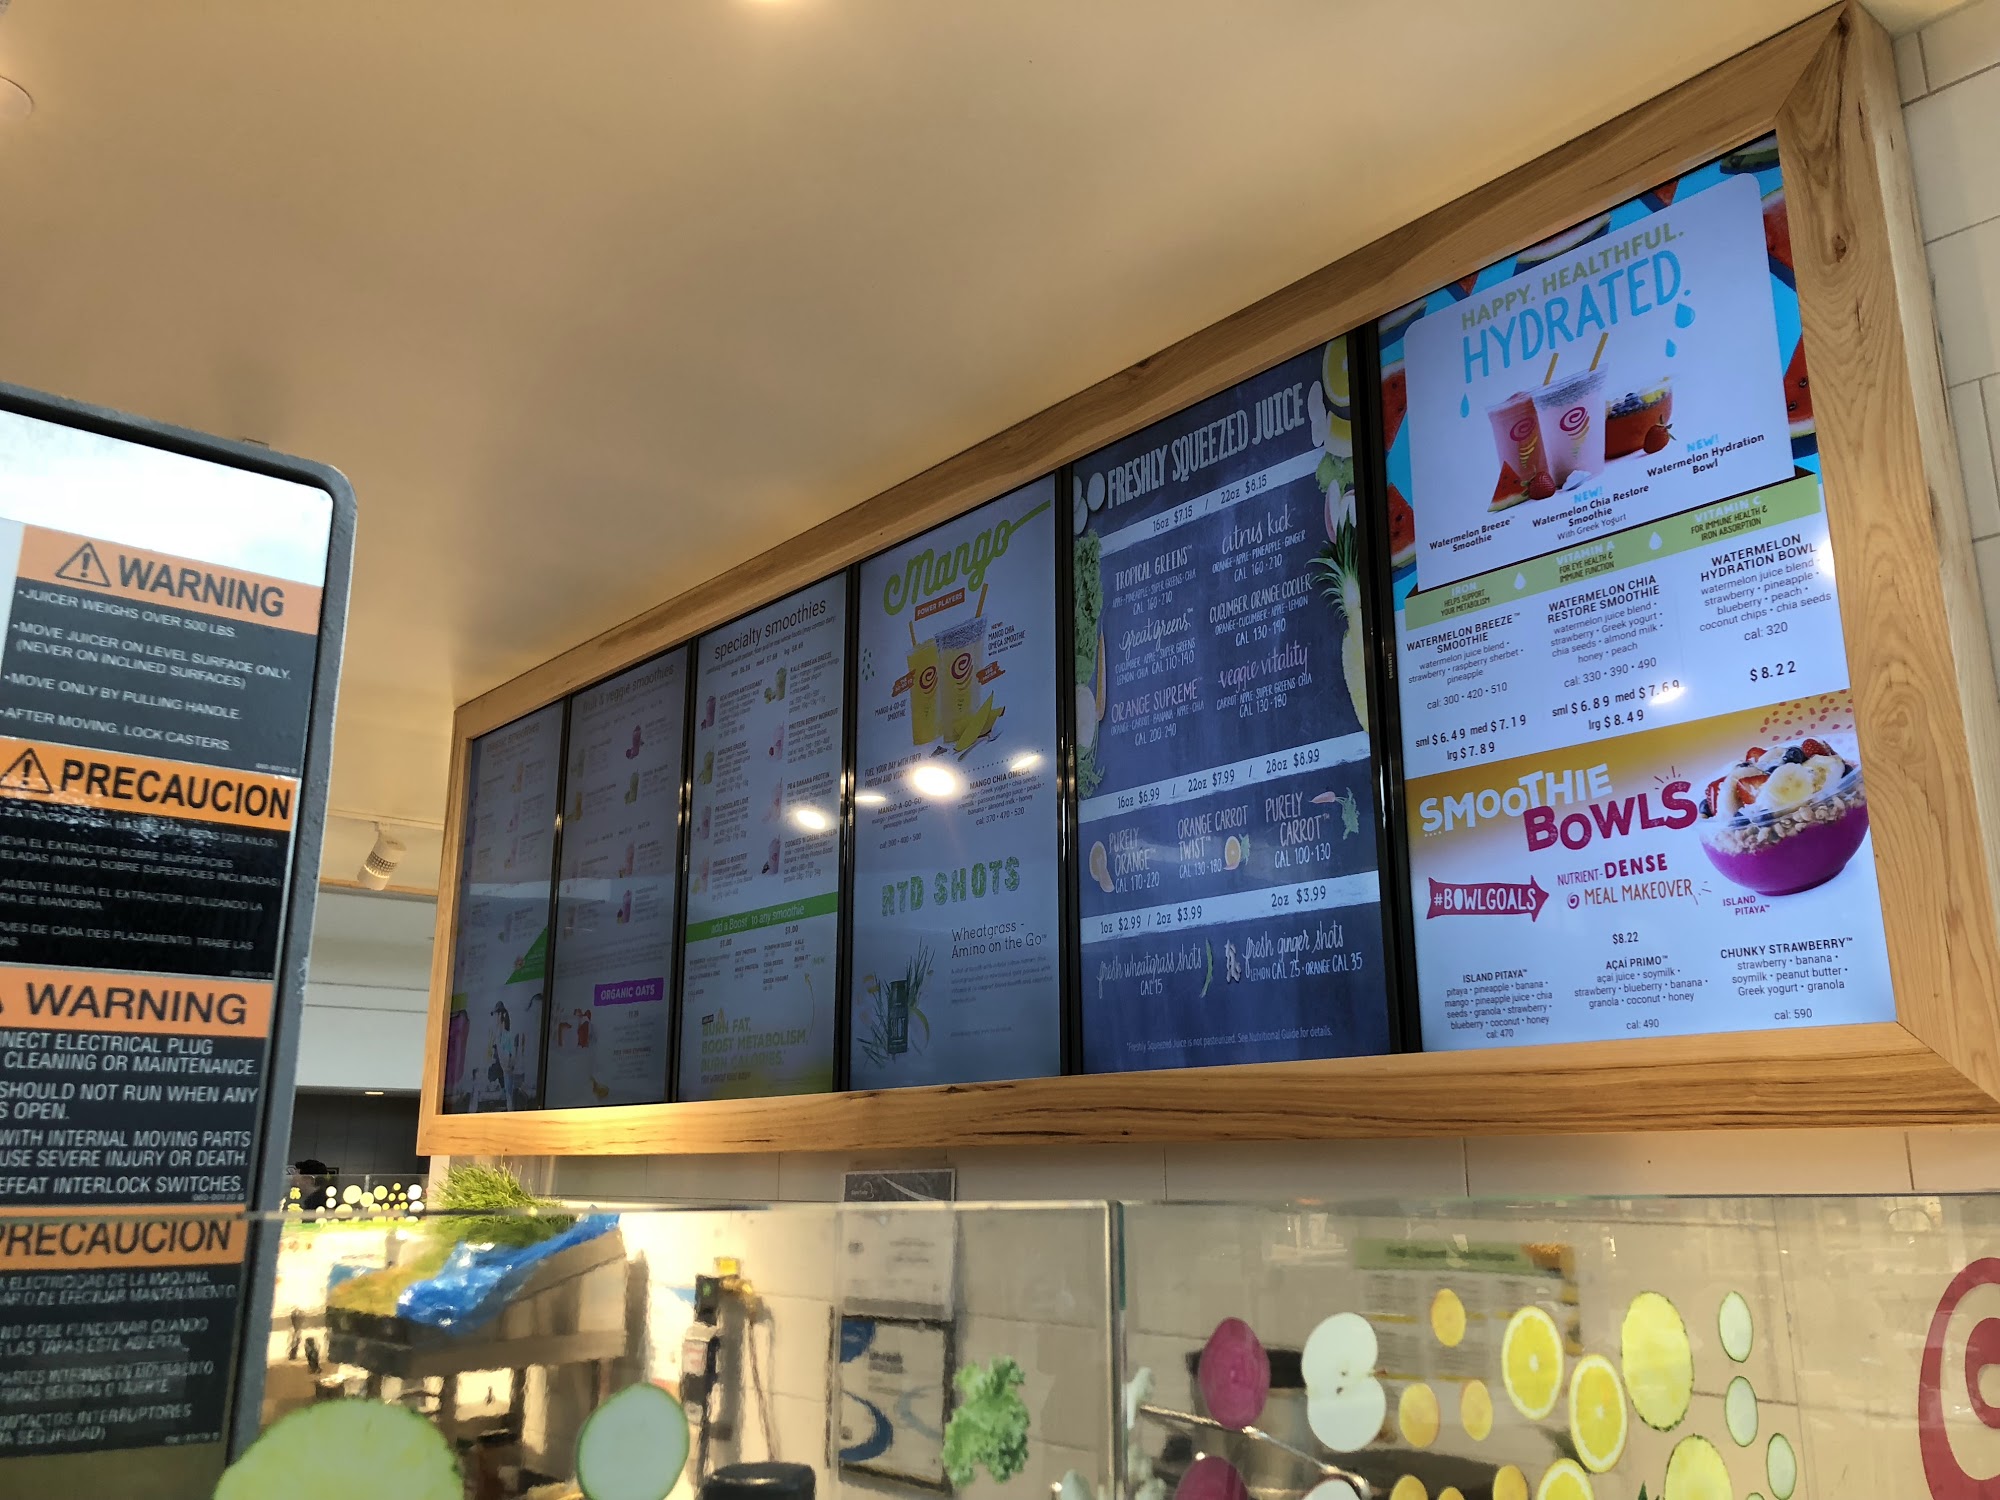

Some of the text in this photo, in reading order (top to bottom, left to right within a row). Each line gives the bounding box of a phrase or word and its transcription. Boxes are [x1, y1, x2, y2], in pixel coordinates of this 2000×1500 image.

[1461, 222, 1684, 331] HAPPY. HEALTHFUL.
[1463, 249, 1691, 384] HYDRATED.
[1107, 382, 1305, 510] FRESHLY SQUEEZED JUICE
[1647, 433, 1765, 478] Watermelon Hydration
[1692, 458, 1719, 476] Bowl
[1152, 517, 1170, 532] 16oz
[1173, 504, 1193, 525] $7.15
[1220, 488, 1240, 505] 22oz
[1532, 483, 1649, 528] Watermelon Chia Restore
[1568, 505, 1613, 528] Smoothie
[1221, 521, 1263, 555] citrus
[1429, 526, 1479, 550] Watermelon
[1452, 533, 1492, 552] Smoothie
[1711, 534, 1802, 567] WATERMELON
[883, 504, 1045, 616] Mango
[1115, 561, 1151, 592] TROPICAL
[1700, 542, 1816, 582] HYDRATION BOWL
[1700, 558, 1815, 595] watermelon juice blend
[118, 554, 285, 618] WARNING
[1209, 573, 1312, 624] CUCUMBER ORANGE COOLER
[1549, 575, 1656, 612] WATERMELON CHIA
[25, 589, 78, 608] JUICER
[82, 598, 139, 620] WEIGHS
[142, 610, 181, 628] OVER
[209, 623, 238, 638] LBS.
[916, 591, 963, 617] POWER PLAYERS
[1548, 585, 1660, 624] RESTORE SMOOTHIE
[714, 627, 762, 662] specialty
[765, 599, 826, 640] smoothies
[1406, 625, 1473, 651] WATERMELON
[1437, 631, 1489, 654] SMOOTHIE
[19, 622, 62, 640] MOVE
[67, 631, 118, 650] JUICER
[122, 639, 143, 654] ON
[146, 643, 189, 662] LEVEL
[191, 652, 253, 674] SURFACE
[16, 639, 246, 691] (NEVER ON INCLINED SURFACES)
[1218, 639, 1309, 694] veggie vitality
[10, 672, 55, 691] MOVE
[58, 679, 98, 697] ONLY
[101, 686, 120, 700] BY
[123, 691, 183, 711] PULLING
[6, 708, 55, 726] AFTER
[124, 724, 164, 741] LOCK
[1111, 693, 1150, 724] ORANGE
[60, 758, 291, 821] PRECAUCION
[1117, 748, 1320, 809] 16oz $6.99 22oz $7.99 28oz $8.99
[1265, 791, 1304, 823] PURELY
[1419, 764, 1614, 832] SMOOTHIE
[1177, 805, 1249, 839] ORANGE CARROT
[1523, 780, 1698, 852] BOWLS
[1108, 827, 1140, 853] PURELY
[881, 856, 1020, 917] RTD SHOTS
[1271, 884, 1327, 909] 2oz $3.99
[1433, 884, 1536, 912] #BOWLGOALS
[1584, 879, 1692, 906] MEAL MAKEOVER
[1723, 896, 1756, 906] ISLAND
[772, 904, 804, 922] smoothie
[1100, 904, 1202, 935] 1oz $2.99 2oz $3.99
[951, 922, 1017, 944] Wheatgrass
[1242, 920, 1344, 979] fresh ginger shots
[1612, 932, 1638, 945] $8.22
[1720, 946, 1765, 959] CHUNKY
[1738, 954, 1832, 970] strawberry banana
[1096, 953, 1123, 999] fresh
[1124, 946, 1175, 984] wheatgrass
[1738, 980, 1844, 996] Greek yogurt granola
[25, 982, 248, 1026] WARNING
[601, 984, 655, 1001] ORGANIC OATS
[55, 1033, 213, 1055] ELECTRICAL PLUG
[4, 1050, 259, 1076] CLEANING OR MAINTENANCE.
[0, 1081, 259, 1103] SHOULD NOT RUN WHEN ANY
[13, 1102, 70, 1121] OPEN.
[48, 1130, 129, 1148] INTERNAL
[133, 1130, 197, 1148] MOVING
[202, 1130, 251, 1148] PARTS
[37, 1150, 248, 1168] SEVERE INJURY OR DEATH.
[53, 1175, 244, 1194] INTERLOCK SWITCHES.
